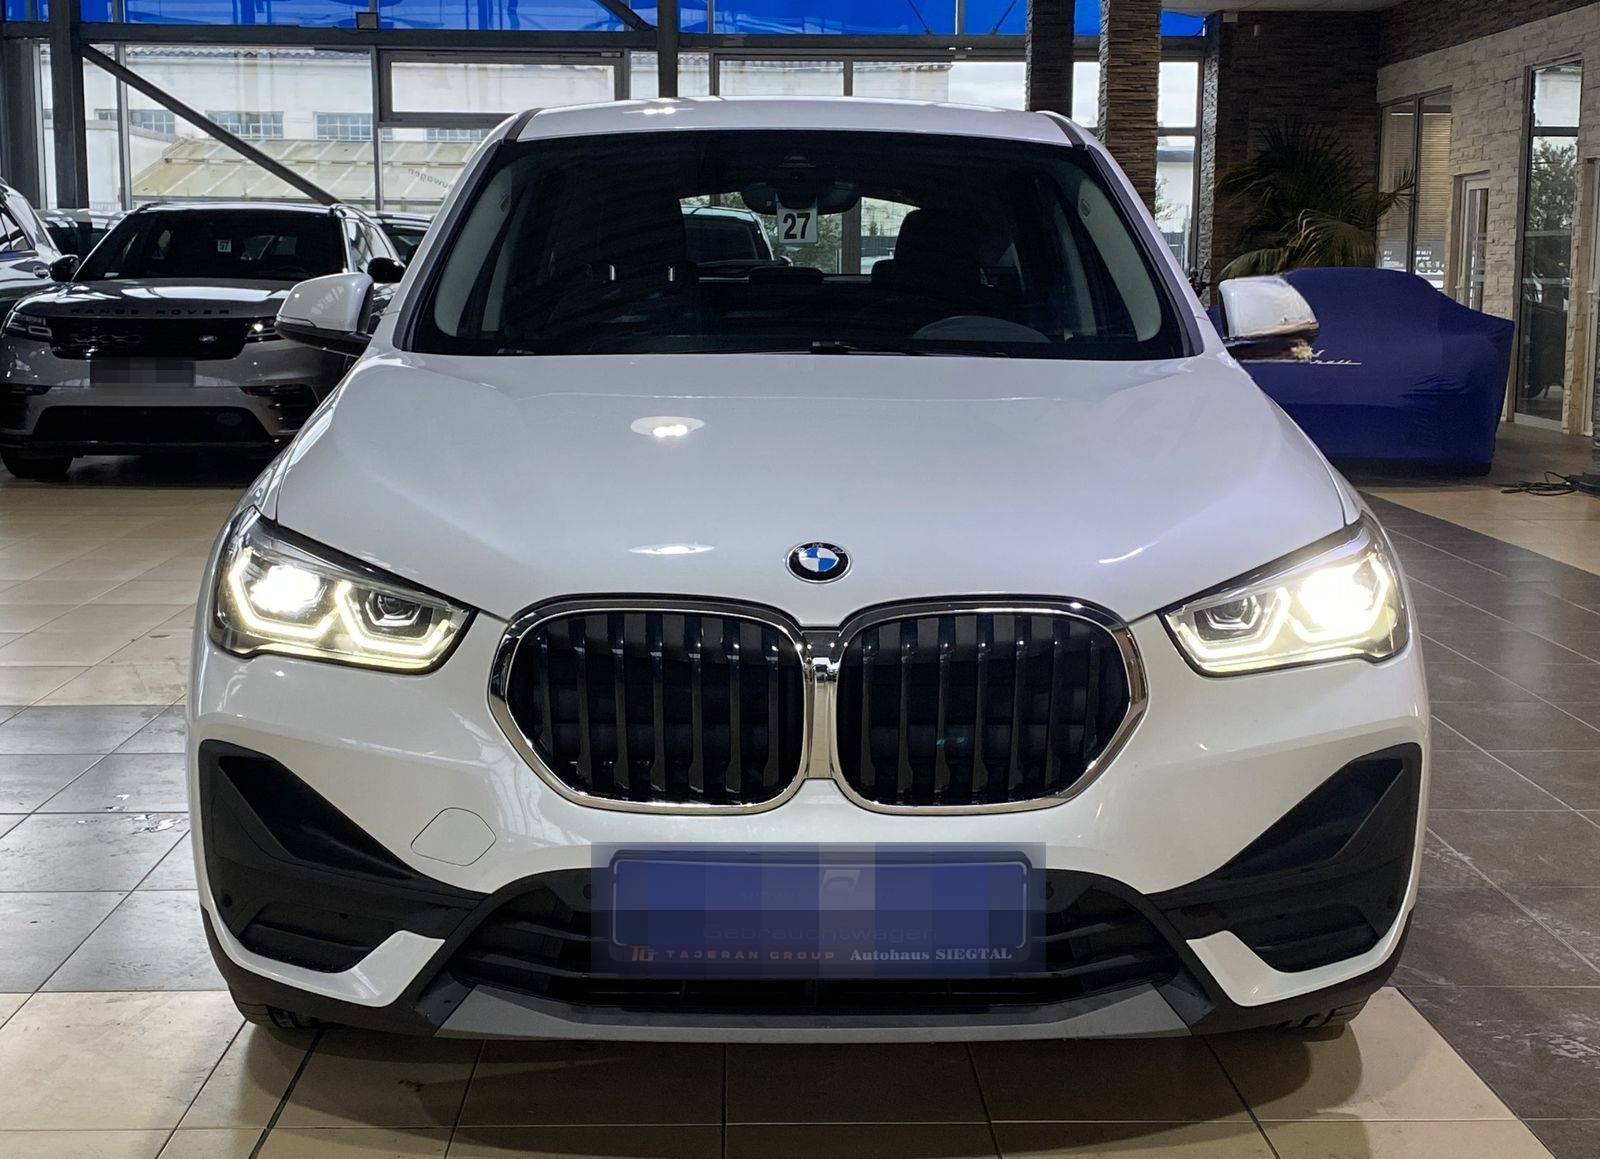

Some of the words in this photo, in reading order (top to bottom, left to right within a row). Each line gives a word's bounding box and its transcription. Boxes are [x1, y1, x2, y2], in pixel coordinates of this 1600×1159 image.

[783, 212, 811, 239] 27
[703, 923, 938, 943] Gebrauchtwagen
[666, 950, 759, 960] TAJERAN
[769, 950, 836, 960] GROUP
[850, 949, 930, 961] Autohaus
[935, 947, 1012, 961] SIEGTAL
